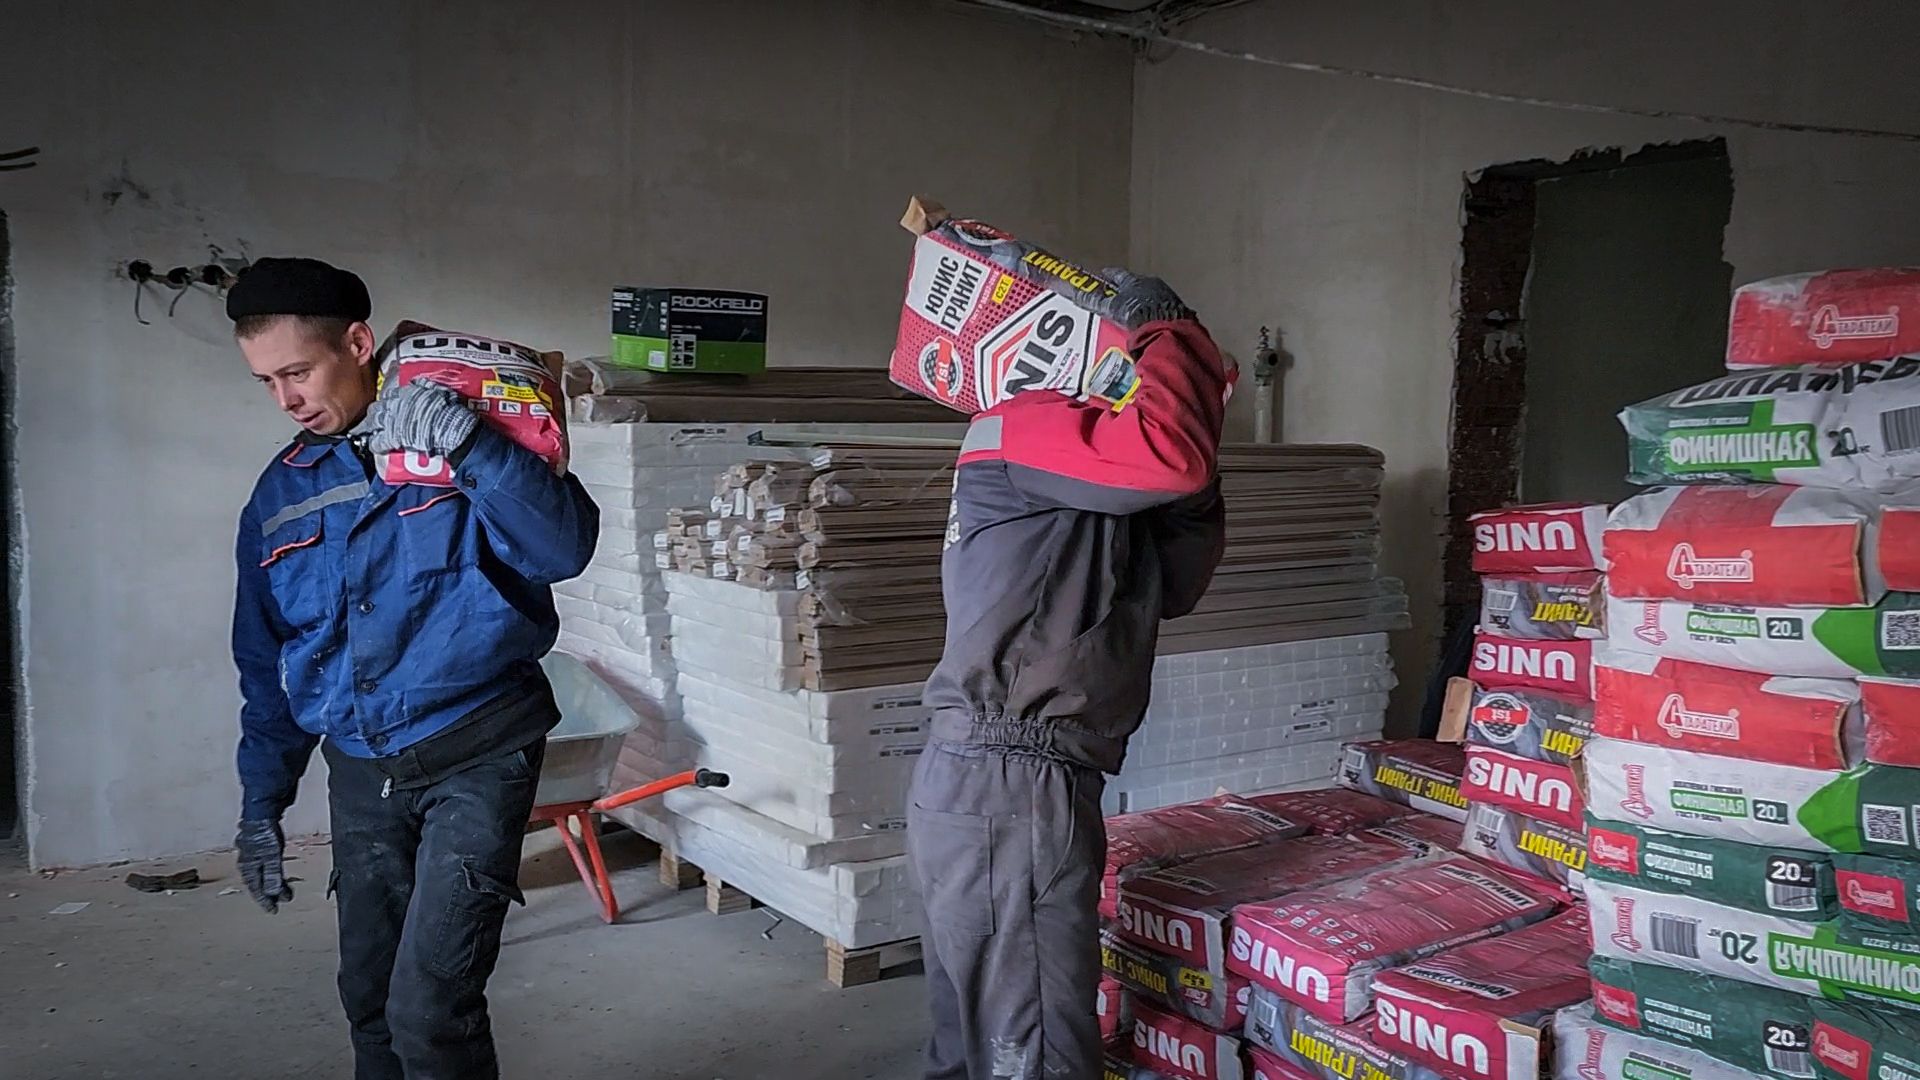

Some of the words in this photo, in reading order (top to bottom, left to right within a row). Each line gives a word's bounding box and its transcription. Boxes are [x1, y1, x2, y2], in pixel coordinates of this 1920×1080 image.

[925, 256, 959, 315] ЮНИС
[1021, 251, 1100, 293] ГРАНИТ
[671, 295, 763, 310] ROCKFIELD
[940, 260, 984, 330] ГРАНИТ
[1669, 429, 1812, 466] ФИНИШНАЯ
[1475, 520, 1577, 552] UNIS
[1769, 619, 1792, 637] 20
[1474, 642, 1576, 682] UNIS
[1374, 765, 1423, 792] ГРАНИТ
[1467, 756, 1573, 813] UNIS
[1755, 802, 1778, 820] 20
[1518, 830, 1588, 871] ГРАНИТ
[1770, 860, 1800, 882] 20
[1120, 901, 1193, 952] UNIS
[1231, 927, 1331, 1003] UNIS
[1720, 931, 1760, 965] 20
[1773, 940, 1920, 994] ФИНИШНАЯ
[1133, 1018, 1208, 1077] UNIS
[1289, 1028, 1358, 1079] ГРАНИТ
[1376, 997, 1490, 1075] UNIS
[1767, 1026, 1797, 1048] 20
